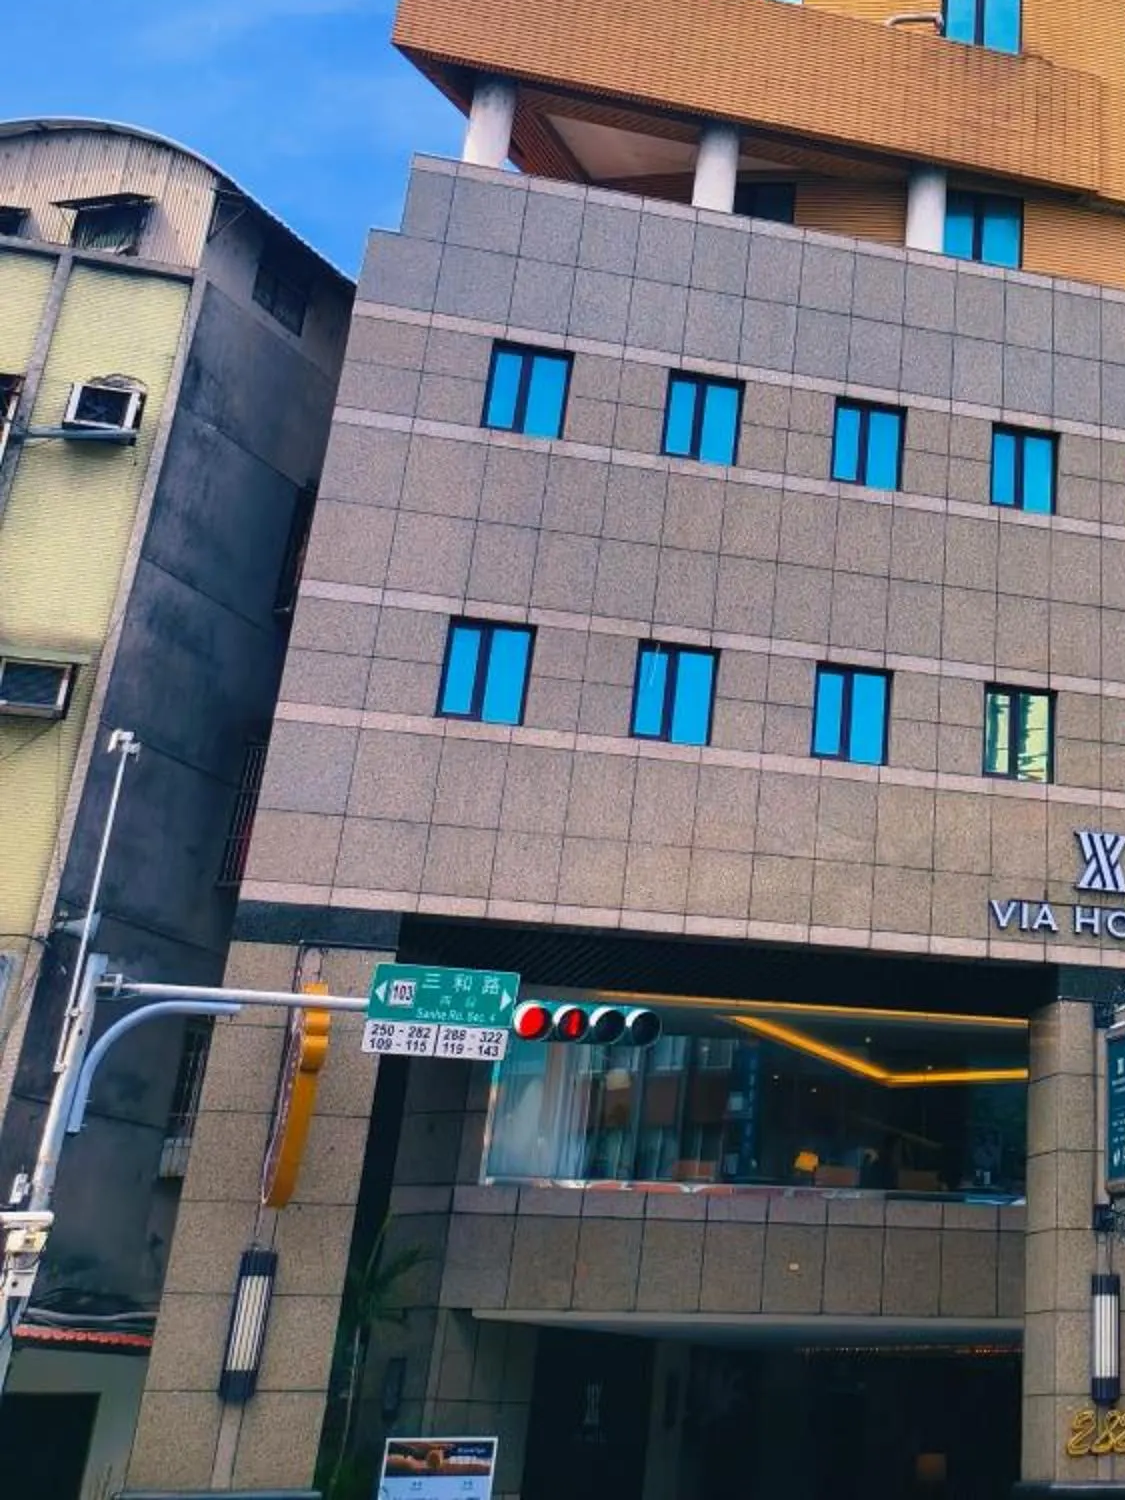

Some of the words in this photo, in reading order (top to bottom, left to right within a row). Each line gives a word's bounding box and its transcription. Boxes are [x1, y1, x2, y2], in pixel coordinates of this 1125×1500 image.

[989, 898, 1058, 931] VIA
[421, 972, 500, 995] 三和路
[394, 984, 414, 1001] 103
[371, 1023, 395, 1037] 250
[408, 1025, 431, 1039] 282
[479, 1031, 503, 1044] 322
[406, 1040, 427, 1053] 115
[479, 1045, 499, 1057] 143
